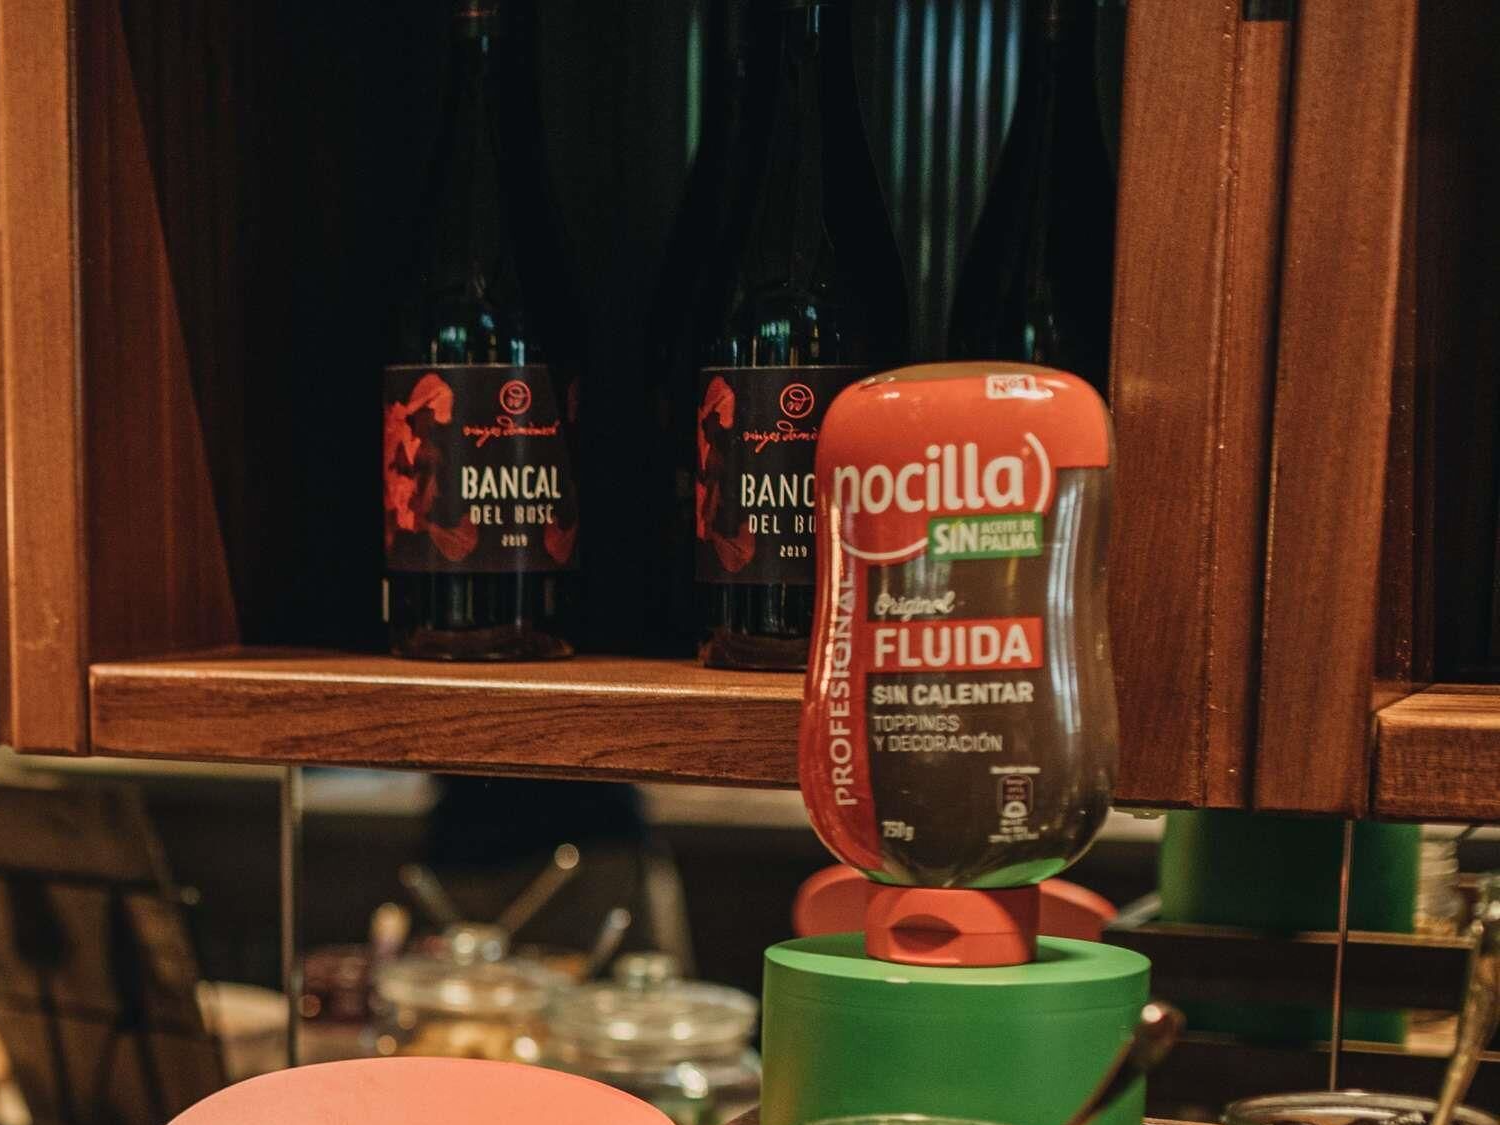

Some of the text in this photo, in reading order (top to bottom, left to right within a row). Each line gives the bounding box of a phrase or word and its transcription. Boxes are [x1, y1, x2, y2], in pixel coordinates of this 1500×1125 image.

[461, 465, 561, 500] BANCAL
[740, 473, 816, 508] BANC
[834, 442, 1025, 515] nocilla
[469, 504, 555, 525] DEL BOSC
[749, 514, 781, 535] DEL
[933, 522, 980, 555] SIN
[980, 533, 1037, 551] PALMA
[779, 545, 808, 558] 2019
[874, 623, 1033, 668] FLUIDA
[829, 569, 858, 806] PROFESIONAL
[871, 681, 1034, 705] SIN CALENTAR
[872, 714, 960, 733] TOPPINGS
[872, 732, 1003, 752] Y DECORACIÓN
